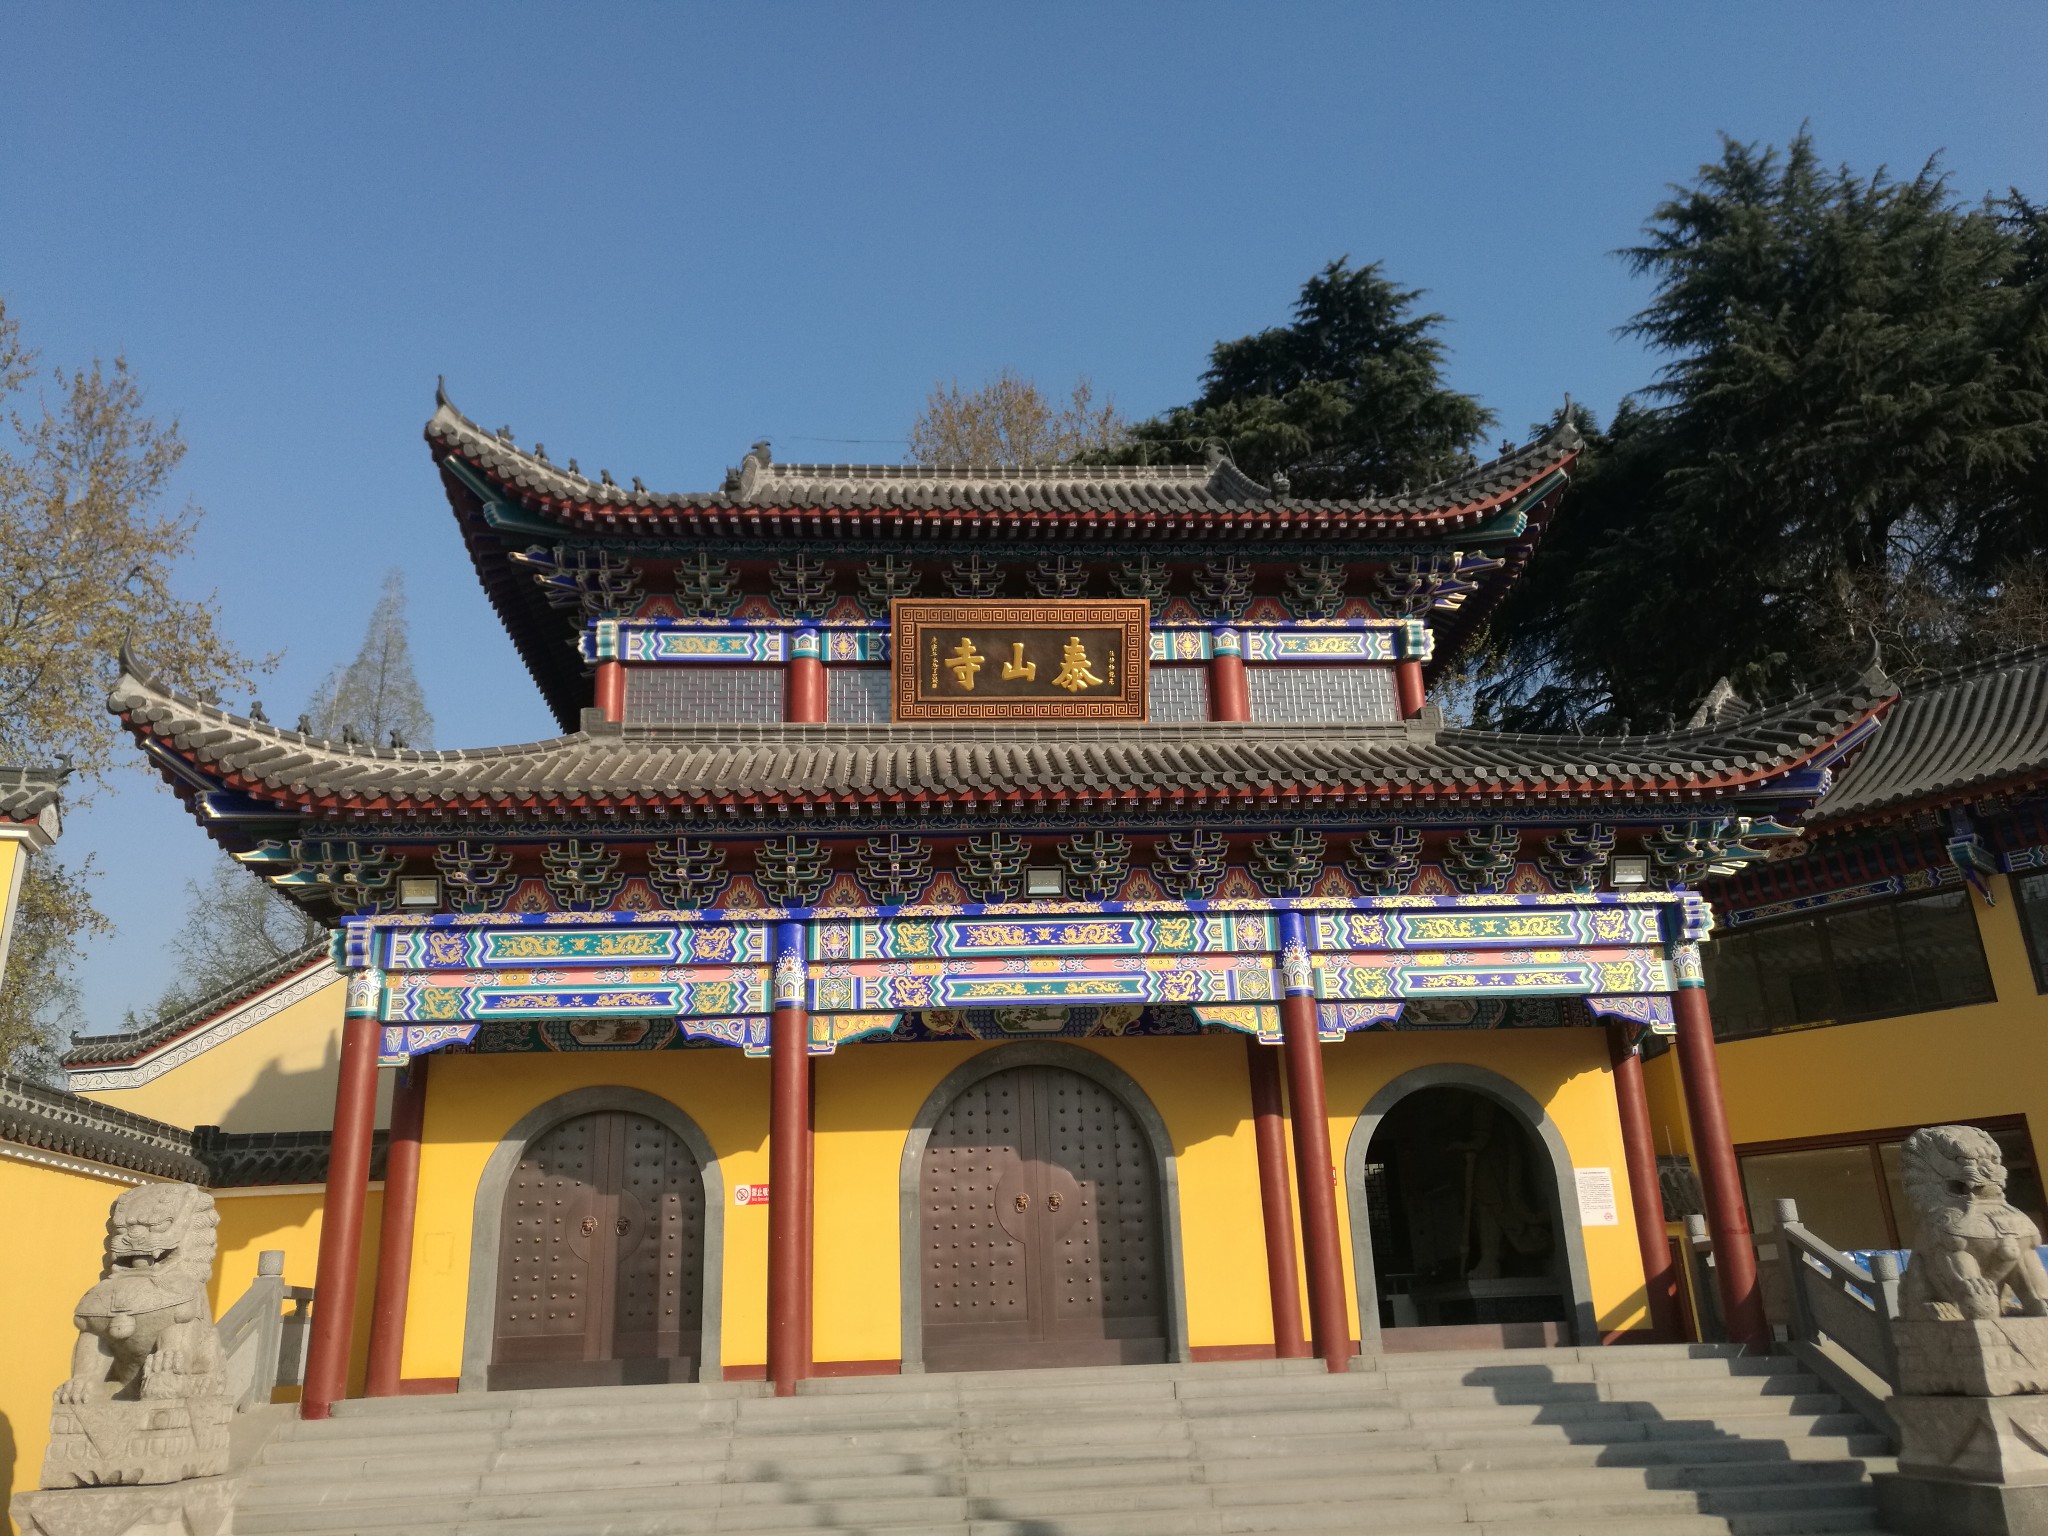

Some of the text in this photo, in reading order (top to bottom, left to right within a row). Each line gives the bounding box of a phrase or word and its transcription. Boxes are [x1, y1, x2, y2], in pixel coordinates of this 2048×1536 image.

[944, 636, 1104, 693] 泰山寺
[752, 1187, 769, 1197] 禁止吸
